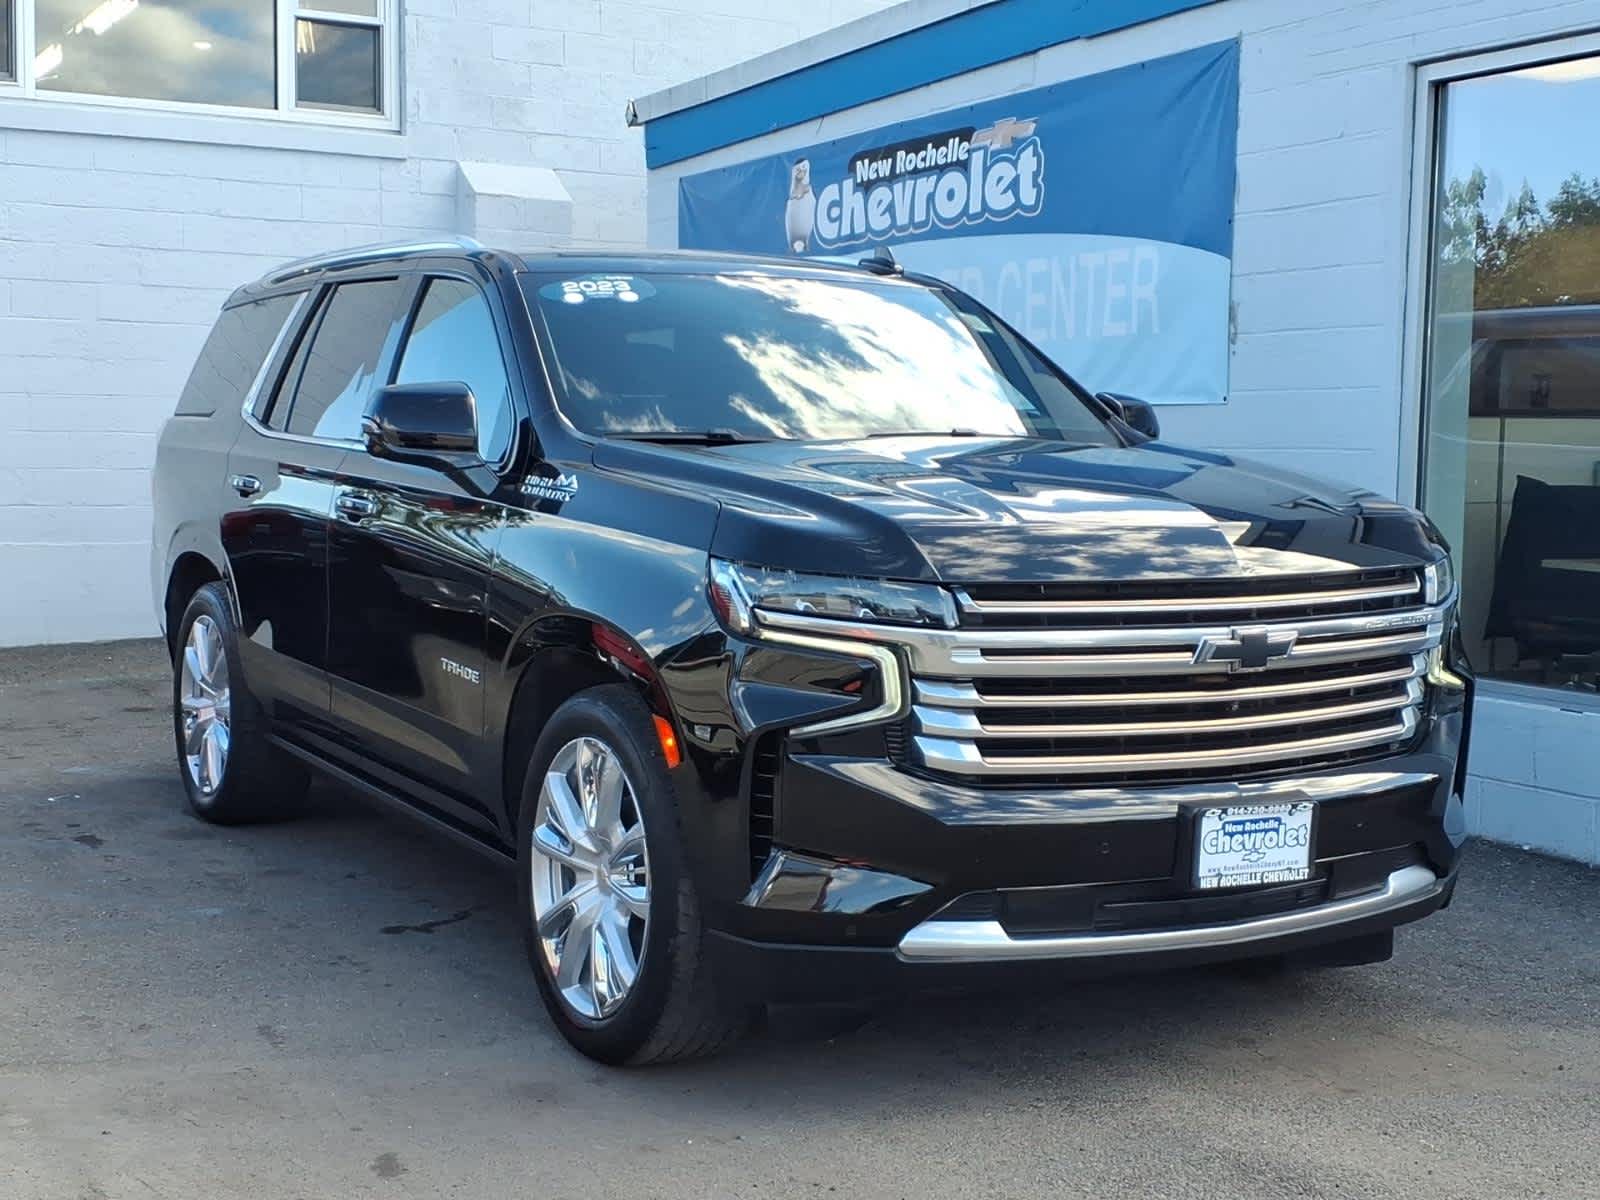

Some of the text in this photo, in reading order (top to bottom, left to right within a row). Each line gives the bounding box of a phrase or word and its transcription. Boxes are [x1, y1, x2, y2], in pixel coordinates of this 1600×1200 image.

[855, 137, 971, 183] New Rochelle
[815, 146, 1039, 241] Chevrolet
[561, 281, 632, 292] 2023
[998, 245, 1160, 343] CENTER
[440, 657, 480, 684] TAHOE
[1203, 824, 1308, 855] Chevrolet
[1225, 819, 1279, 833] New Rochelle
[1200, 868, 1310, 889] NEW ROCHELLE CHEVROLET
